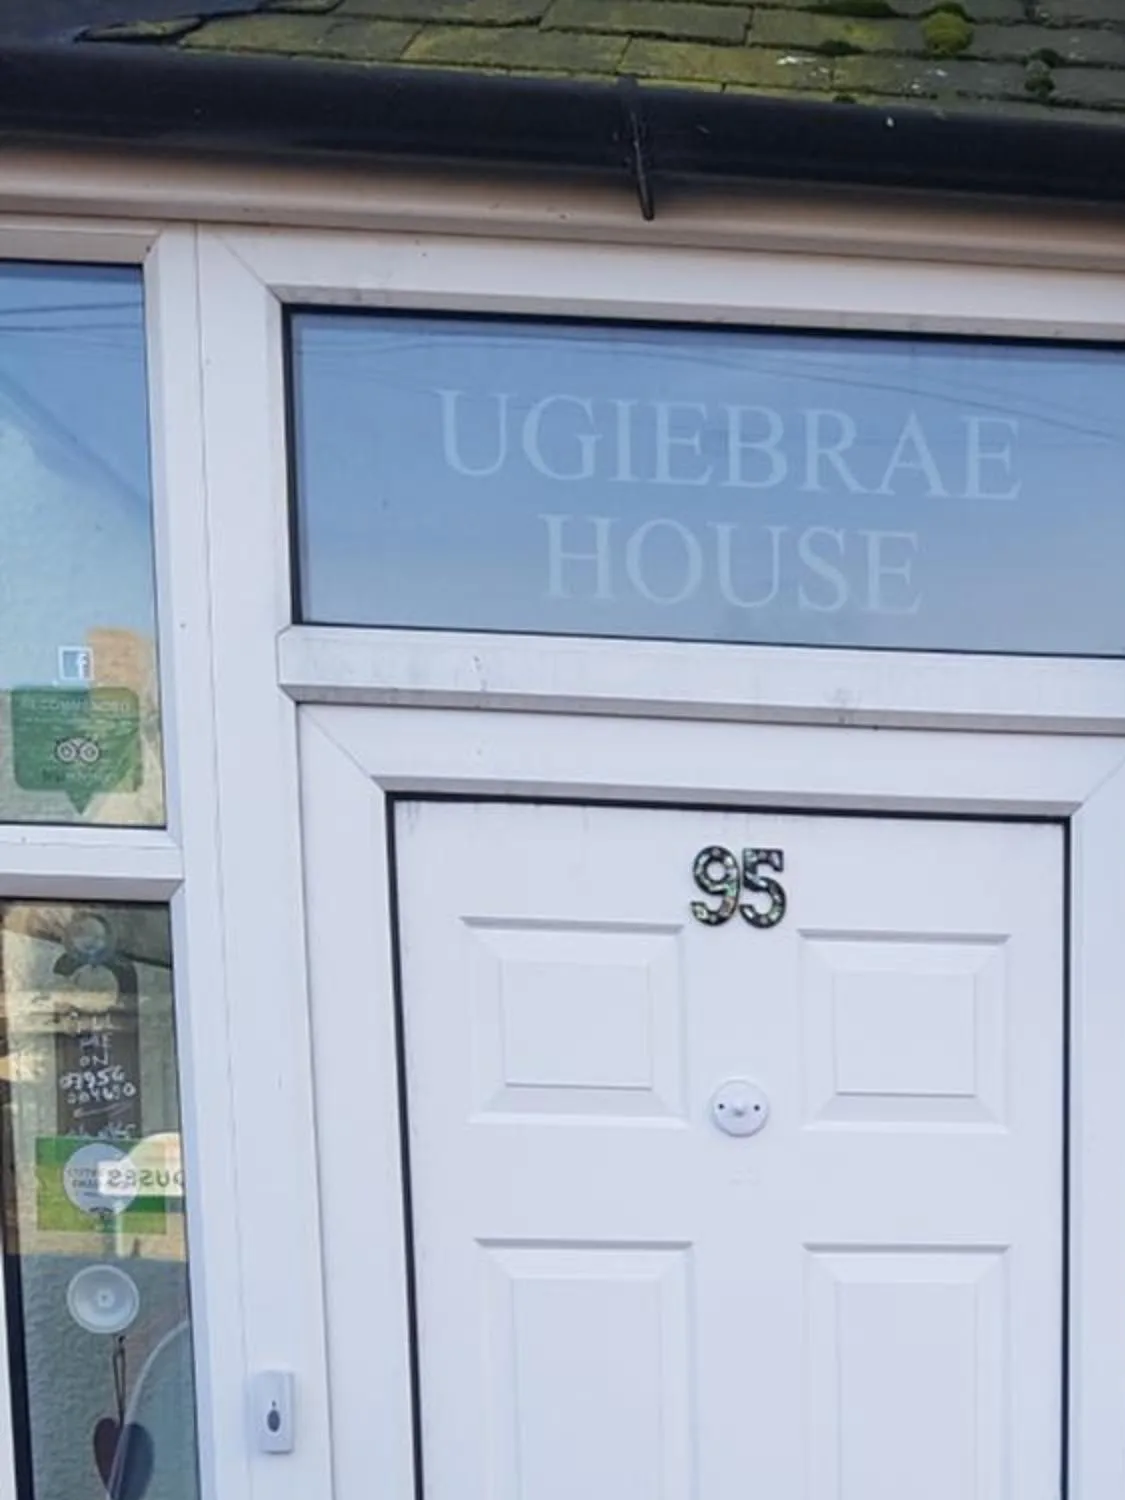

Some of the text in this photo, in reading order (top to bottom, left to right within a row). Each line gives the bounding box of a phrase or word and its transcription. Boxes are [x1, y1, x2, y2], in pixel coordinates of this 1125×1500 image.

[432, 388, 1023, 501] UGIEBRAE
[537, 513, 924, 614] HOUSE
[690, 845, 787, 929] 95
